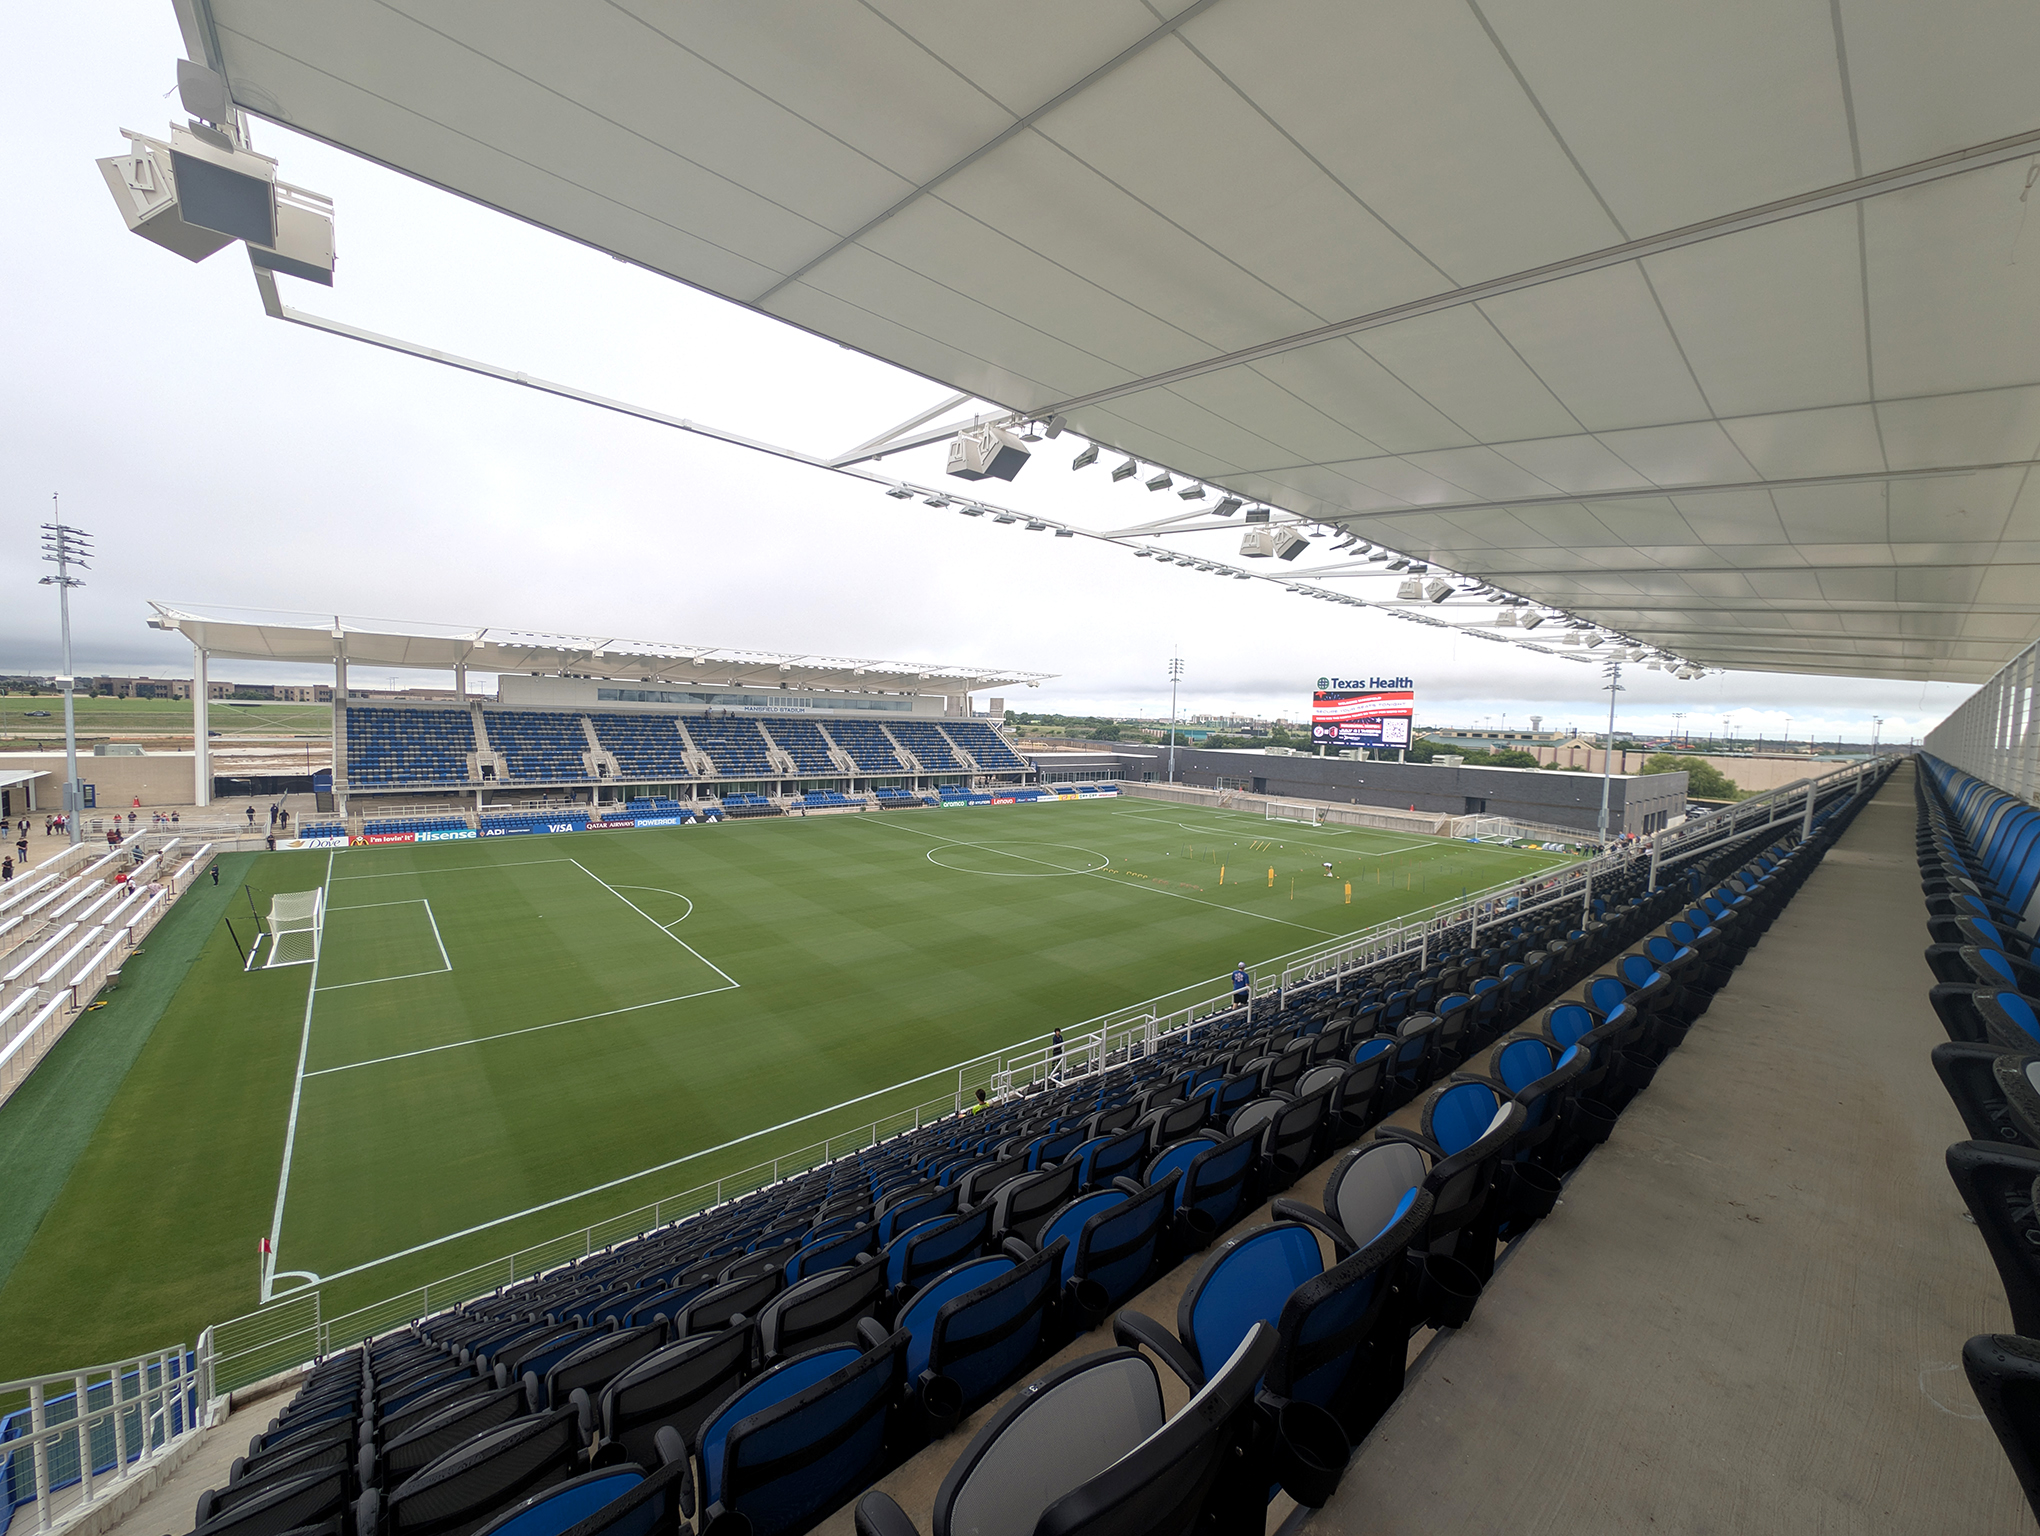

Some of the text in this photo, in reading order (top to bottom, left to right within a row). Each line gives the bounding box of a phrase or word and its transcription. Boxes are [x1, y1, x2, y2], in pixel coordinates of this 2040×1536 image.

[1331, 676, 1413, 689] Texas Health
[586, 822, 608, 830] QATAR
[637, 818, 677, 827] POWERADE
[486, 828, 505, 836] ADI
[547, 823, 573, 833] VISA
[414, 831, 477, 842] Hisense
[308, 838, 341, 849] Dove
